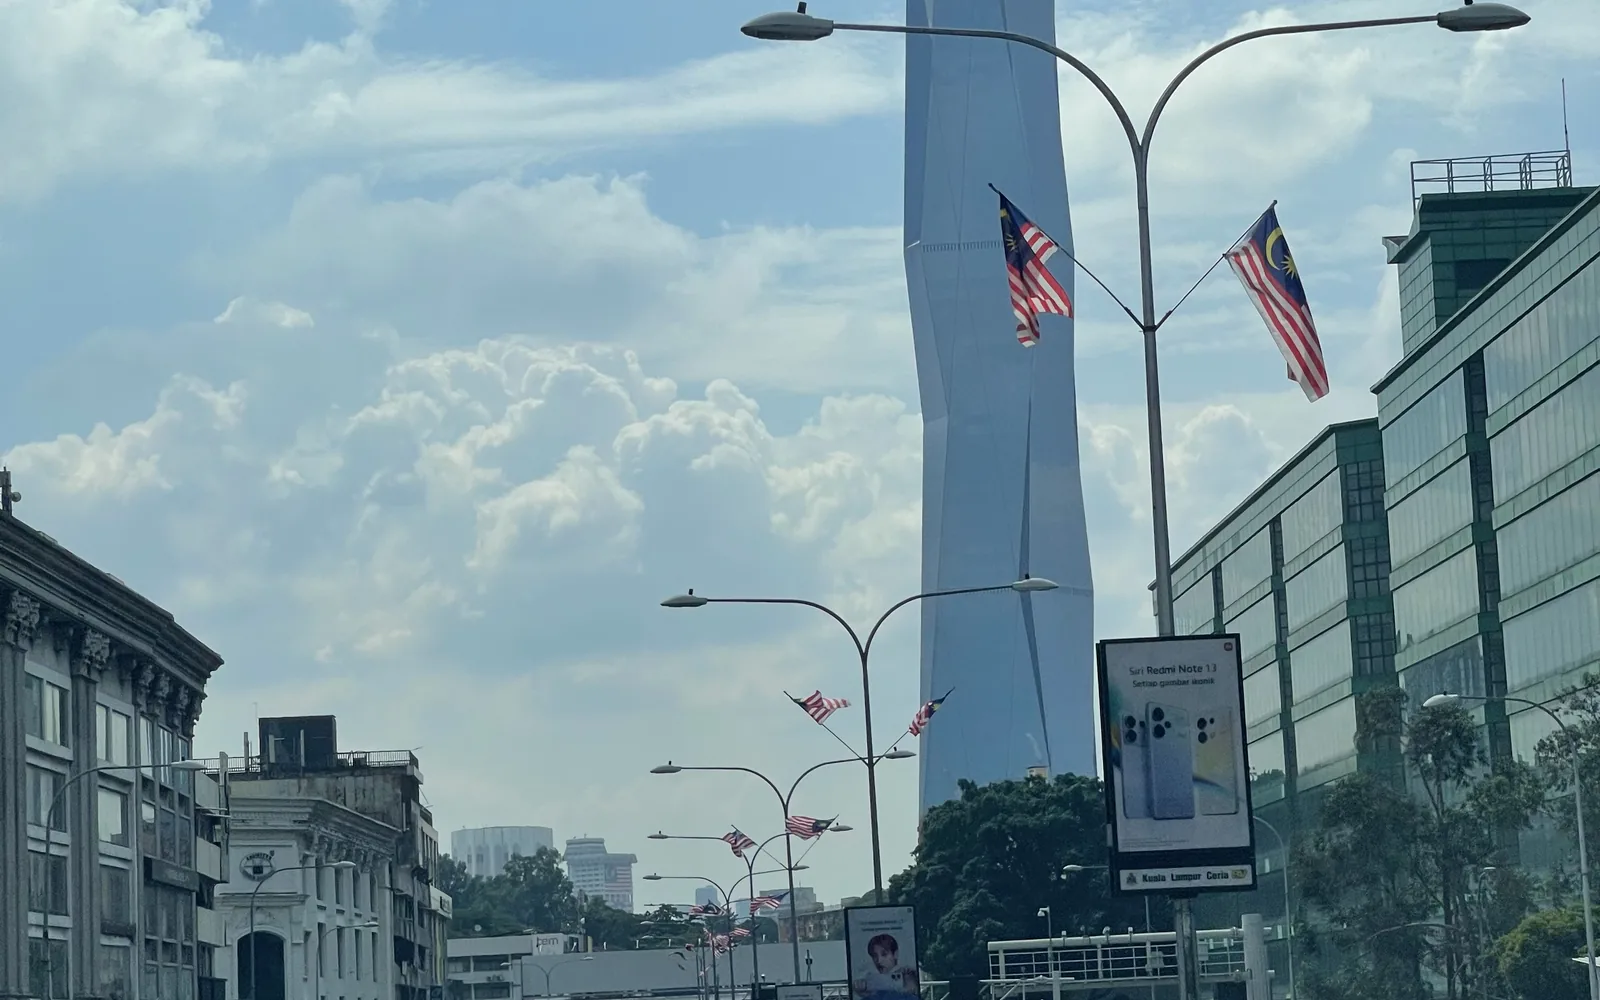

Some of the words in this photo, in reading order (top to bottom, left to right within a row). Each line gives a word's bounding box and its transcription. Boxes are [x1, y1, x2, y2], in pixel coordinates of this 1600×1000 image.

[1129, 667, 1144, 676] Siri
[1147, 665, 1176, 674] Redmi
[1178, 664, 1203, 673] Note
[1206, 664, 1217, 672] 13
[1160, 678, 1189, 688] gambar
[1142, 874, 1166, 882] Kuala
[1171, 872, 1202, 882] Lumpur
[1206, 871, 1229, 880] Ceria
